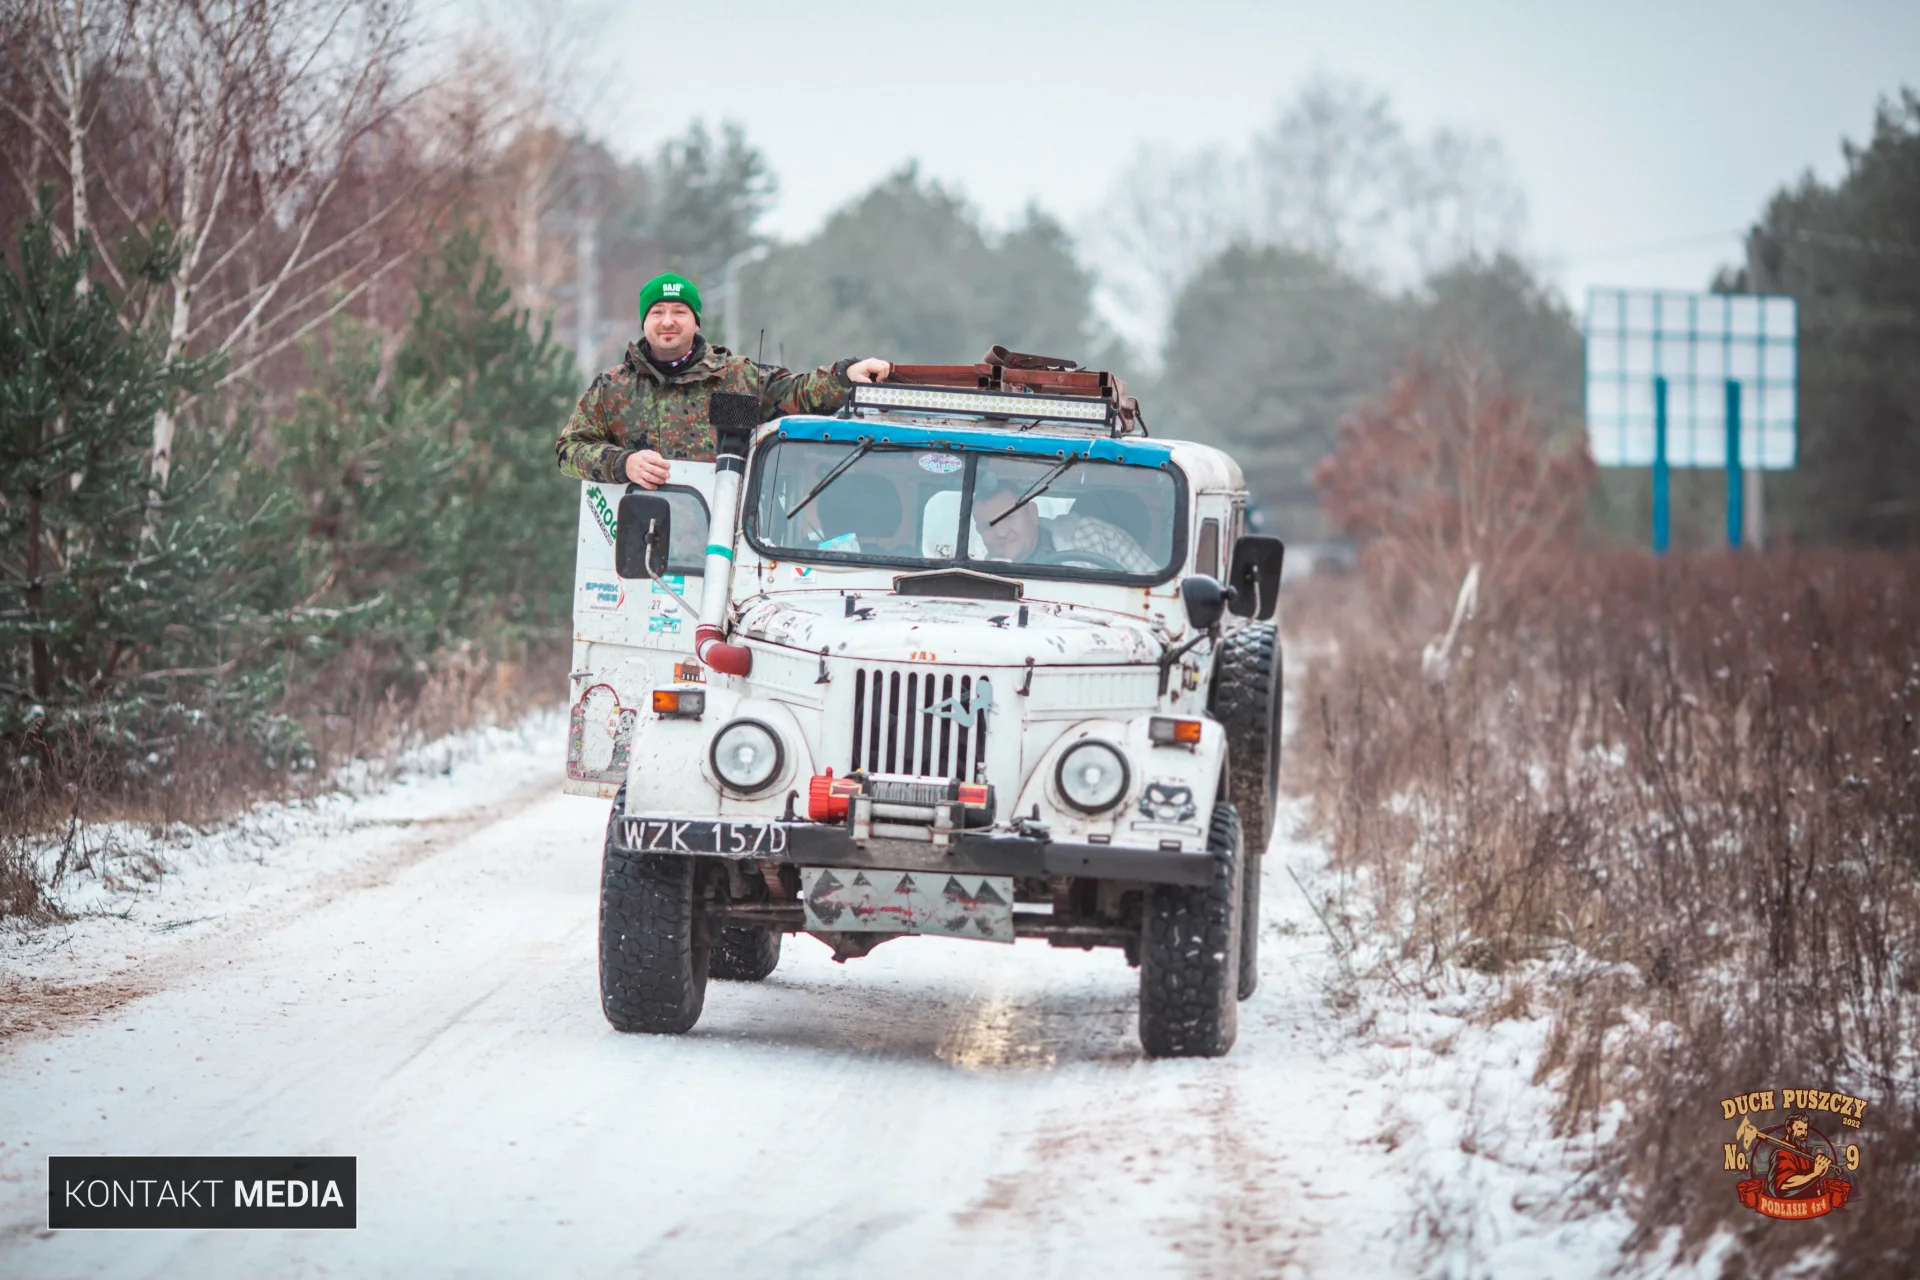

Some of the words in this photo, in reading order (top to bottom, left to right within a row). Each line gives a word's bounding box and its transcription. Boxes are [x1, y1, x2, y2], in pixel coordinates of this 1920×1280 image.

[594, 486, 617, 540] FROG
[624, 820, 692, 852] WZK
[711, 822, 787, 853] 157D
